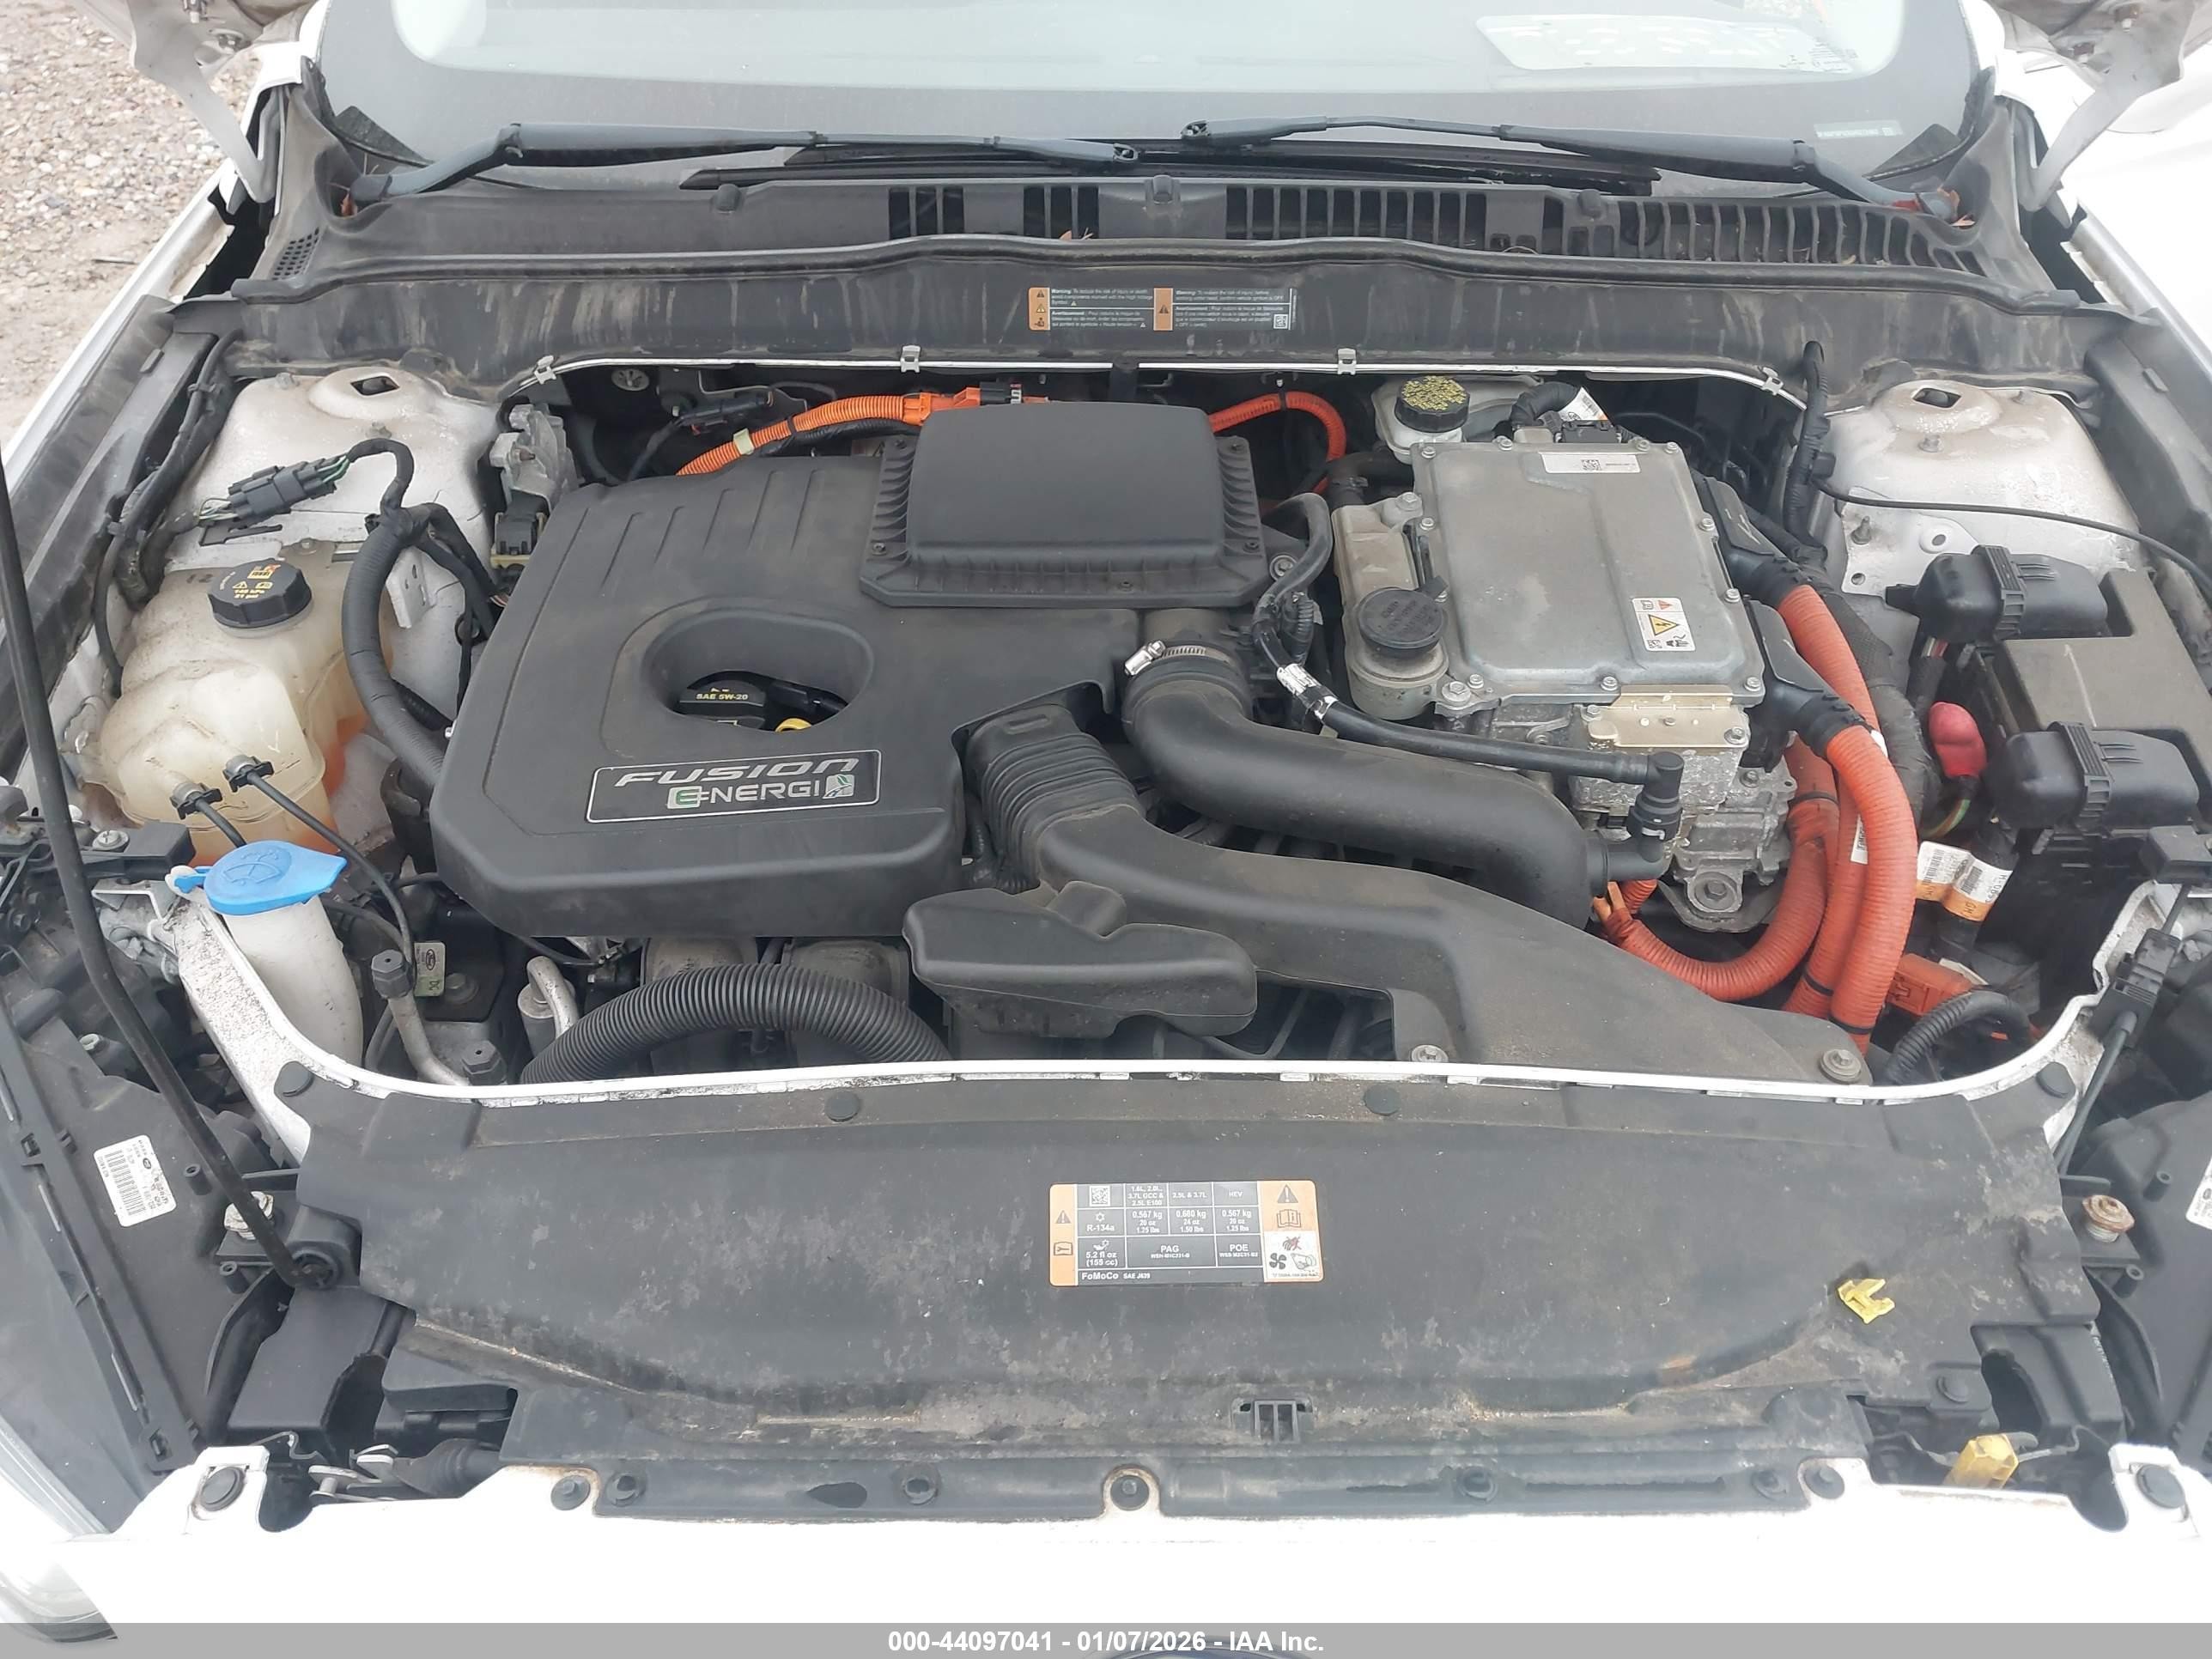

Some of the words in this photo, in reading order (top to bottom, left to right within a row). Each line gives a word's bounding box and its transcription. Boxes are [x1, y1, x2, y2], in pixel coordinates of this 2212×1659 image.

[615, 758, 859, 787] FUSION
[1153, 1211, 1163, 1219] kg
[1196, 1210, 1206, 1218] kg
[1243, 1209, 1252, 1218] kg
[1082, 1272, 1119, 1280] FoMoCo
